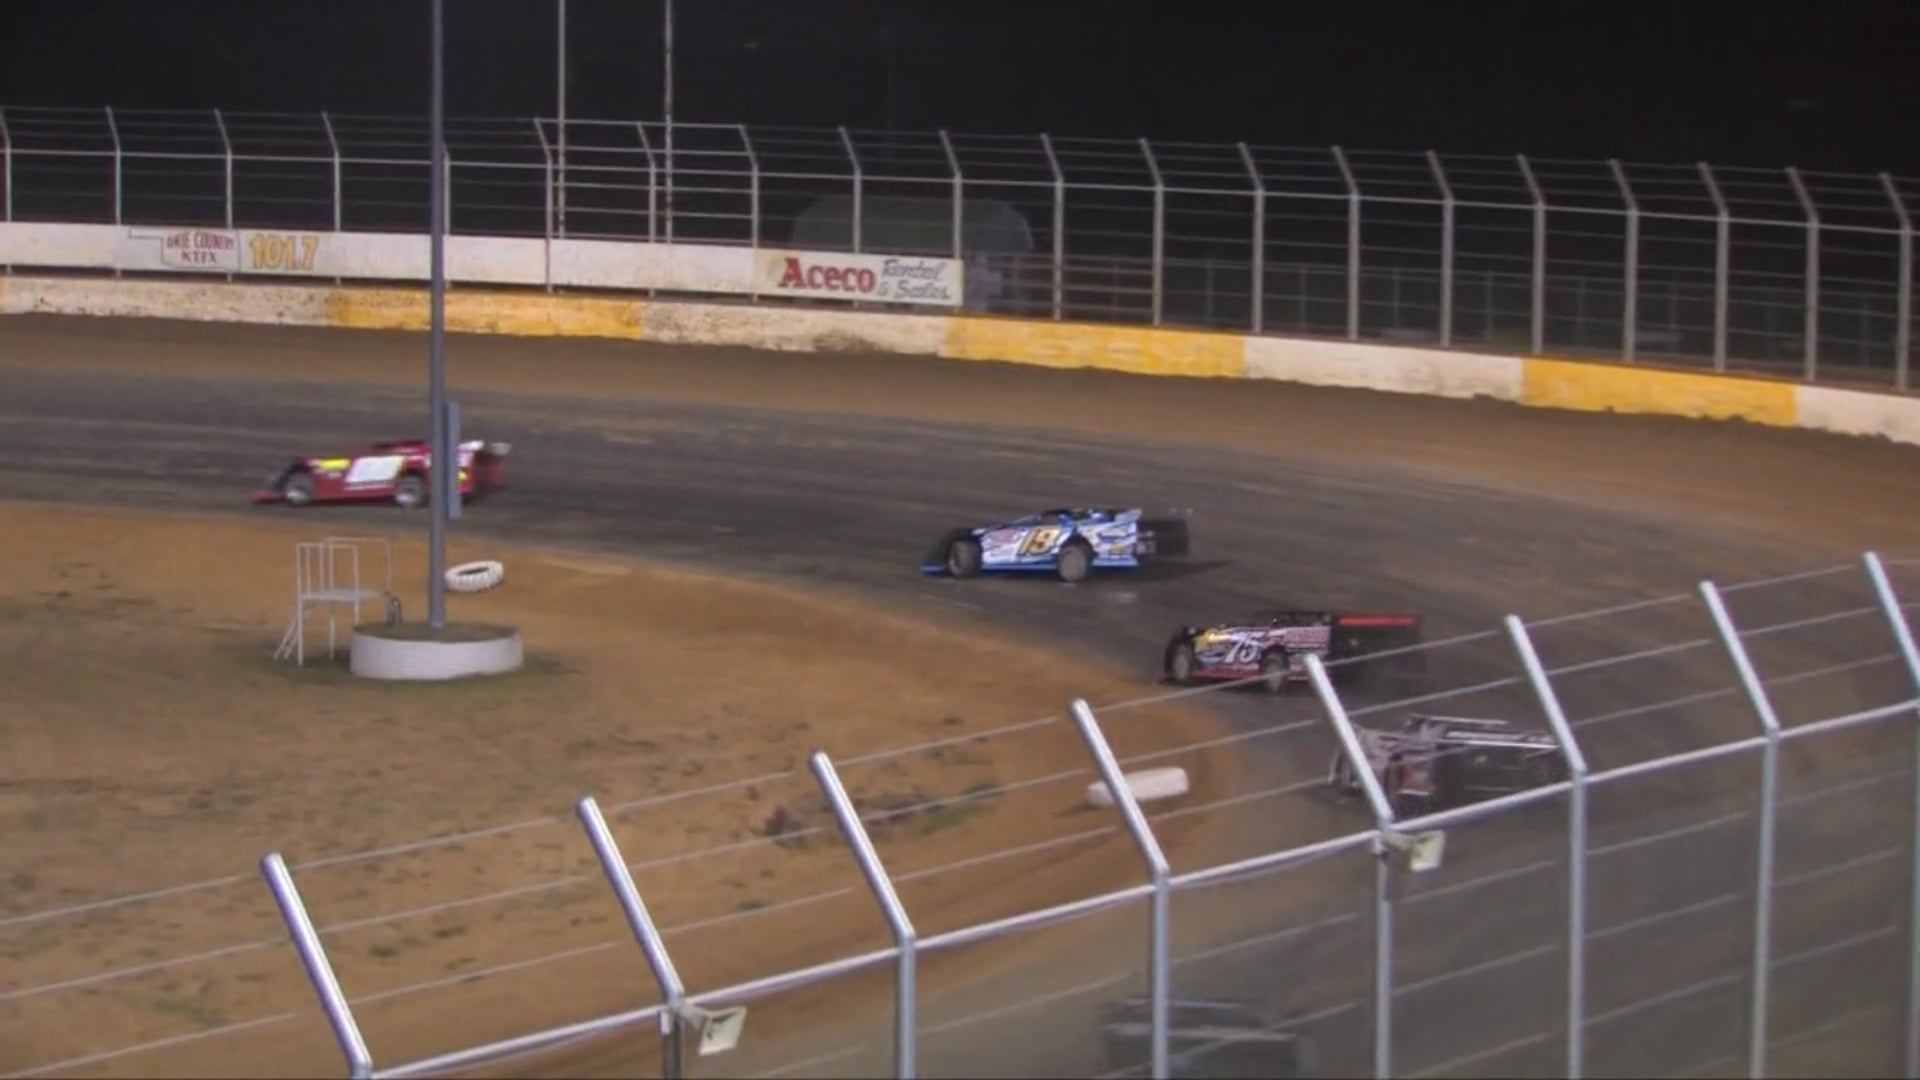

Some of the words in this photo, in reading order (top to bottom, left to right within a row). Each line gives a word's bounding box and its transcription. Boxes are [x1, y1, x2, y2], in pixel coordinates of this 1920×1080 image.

[249, 233, 319, 270] 101.7
[777, 257, 876, 293] Aceco
[894, 281, 951, 300] Sales
[1017, 526, 1062, 556] 19
[1224, 632, 1264, 663] 75
